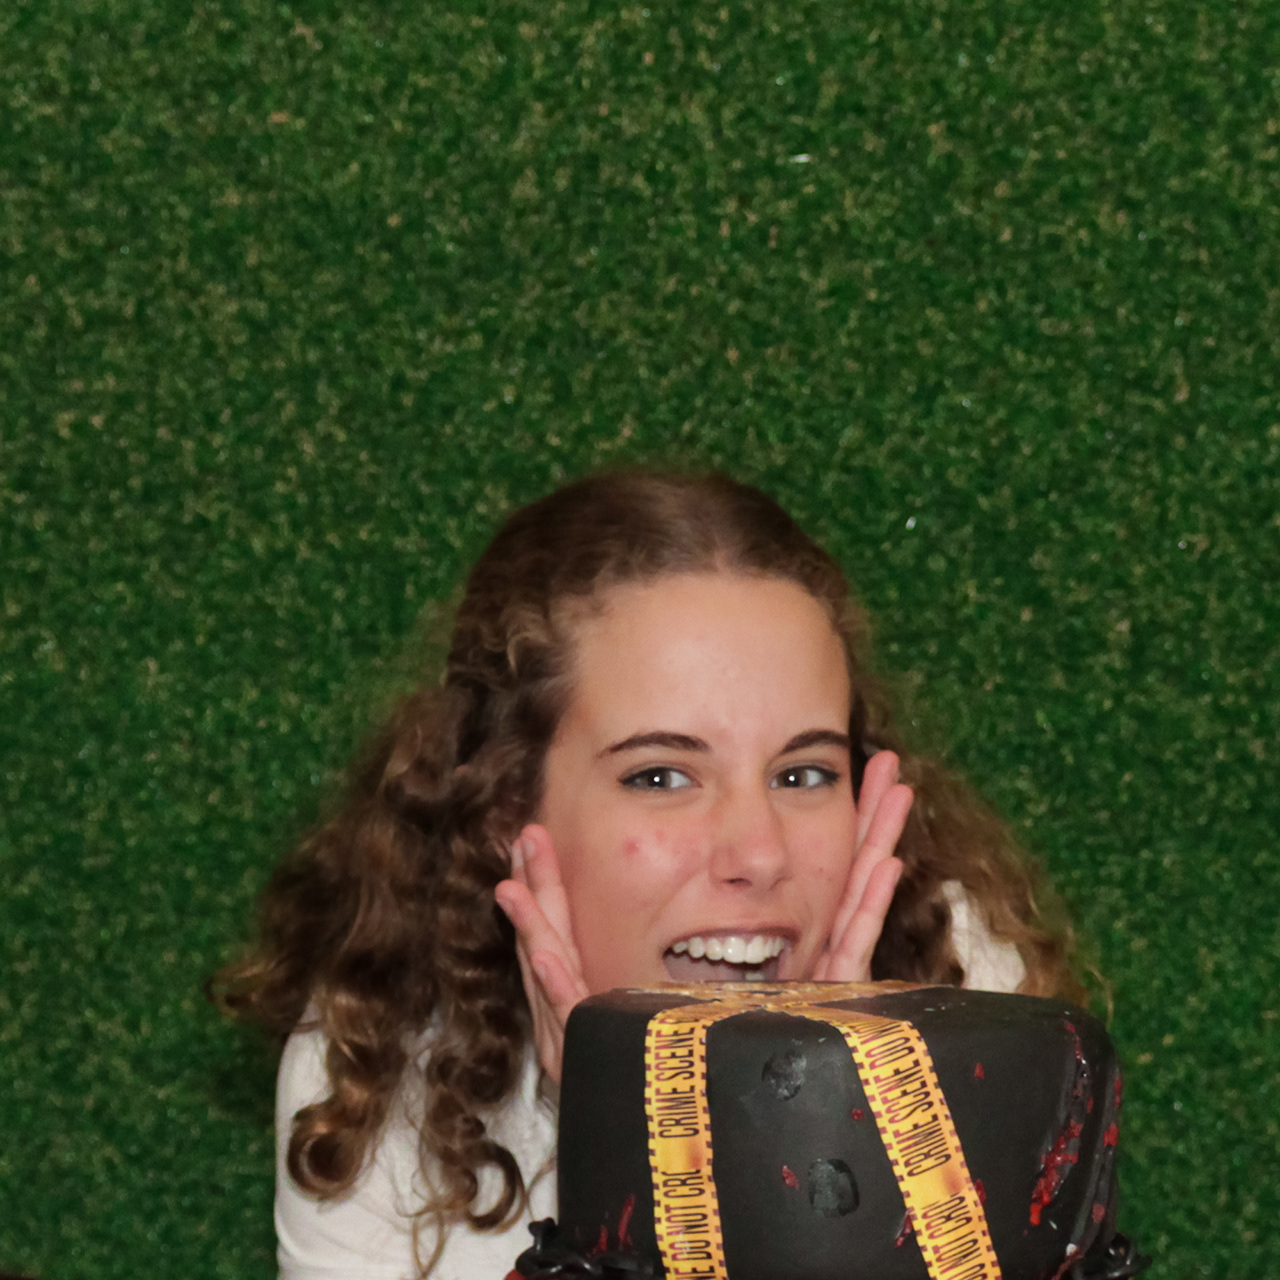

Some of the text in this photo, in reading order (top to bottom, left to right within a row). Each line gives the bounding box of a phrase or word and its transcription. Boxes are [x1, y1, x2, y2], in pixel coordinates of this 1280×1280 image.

[654, 1027, 696, 1081] SCENE
[865, 1037, 916, 1070] DO
[655, 1085, 700, 1138] CRIME
[873, 1059, 934, 1124] SCENE
[892, 1114, 951, 1177] CRIME
[665, 1205, 710, 1236] NOT
[669, 1239, 713, 1261] DO
[932, 1230, 982, 1275] NOT
